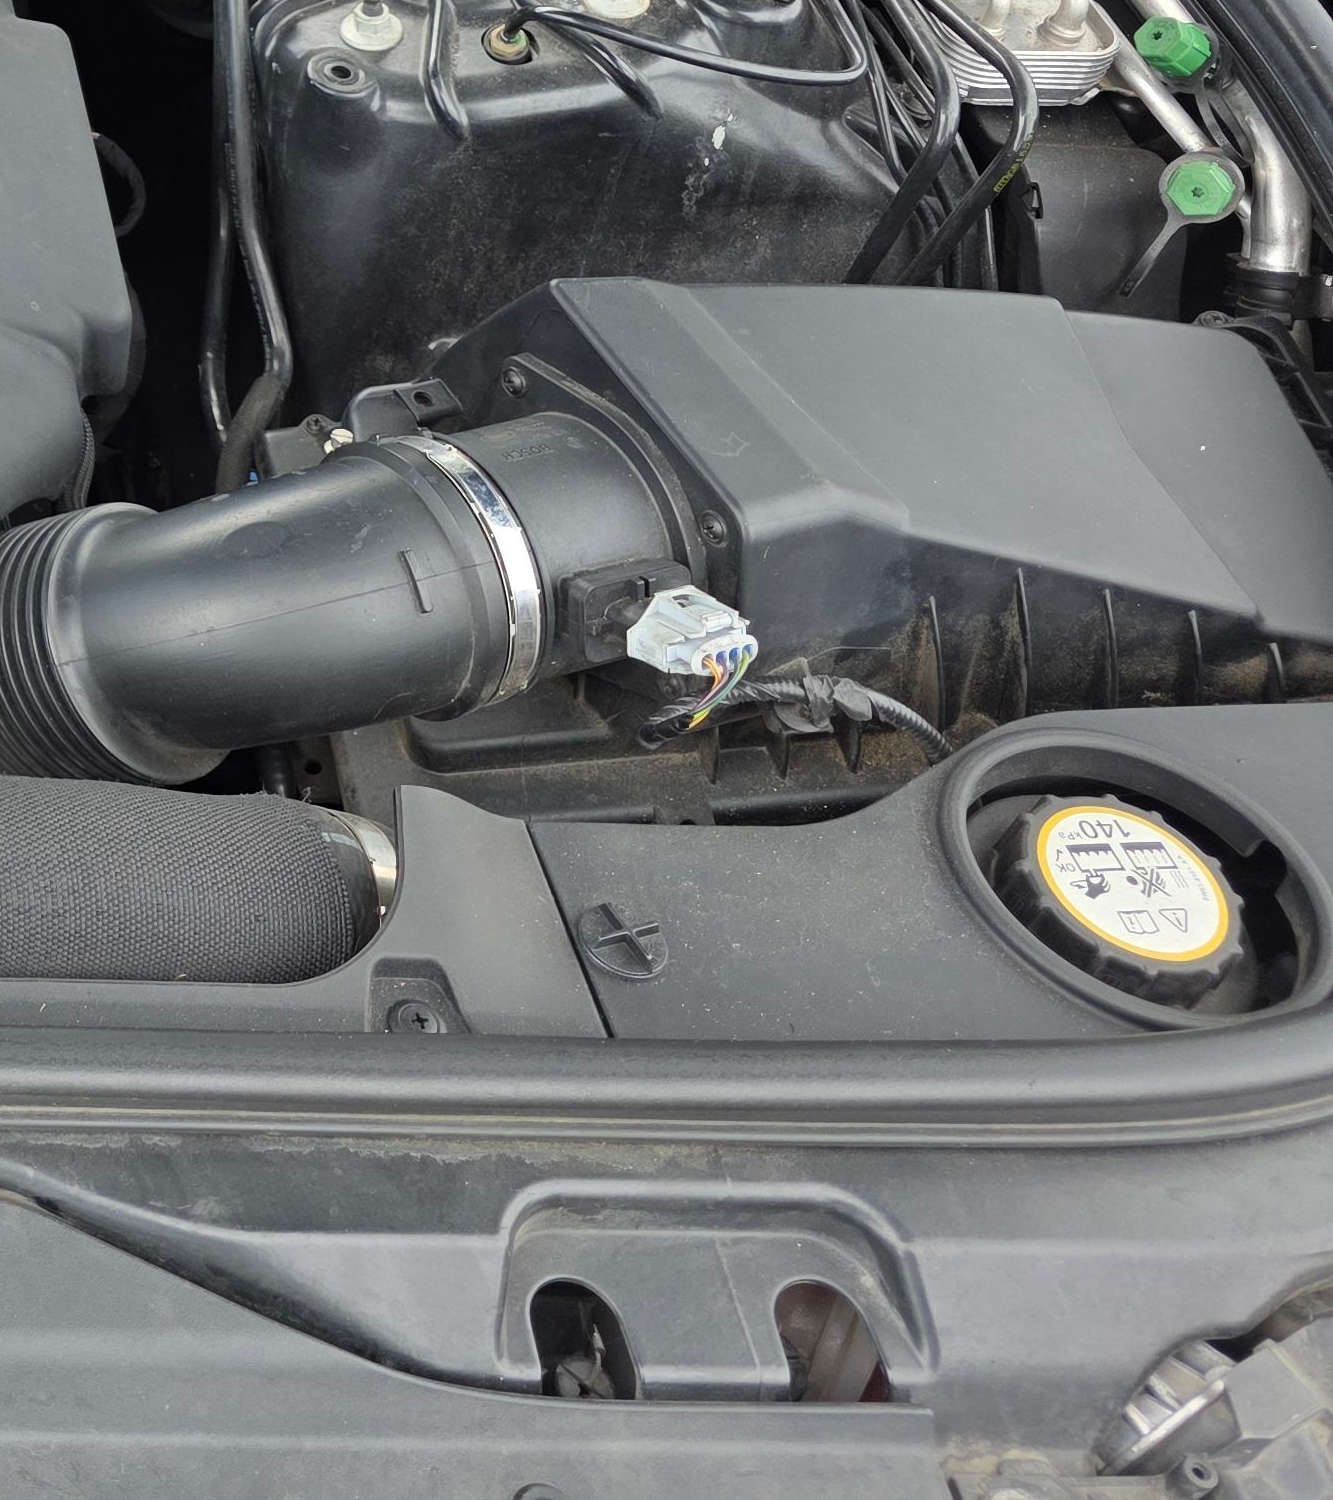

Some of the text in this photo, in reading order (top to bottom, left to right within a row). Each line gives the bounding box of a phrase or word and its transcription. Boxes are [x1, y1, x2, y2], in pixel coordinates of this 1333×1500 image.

[501, 443, 551, 461] BOSCH
[1078, 819, 1131, 839] 140
[1059, 863, 1076, 873] OK
